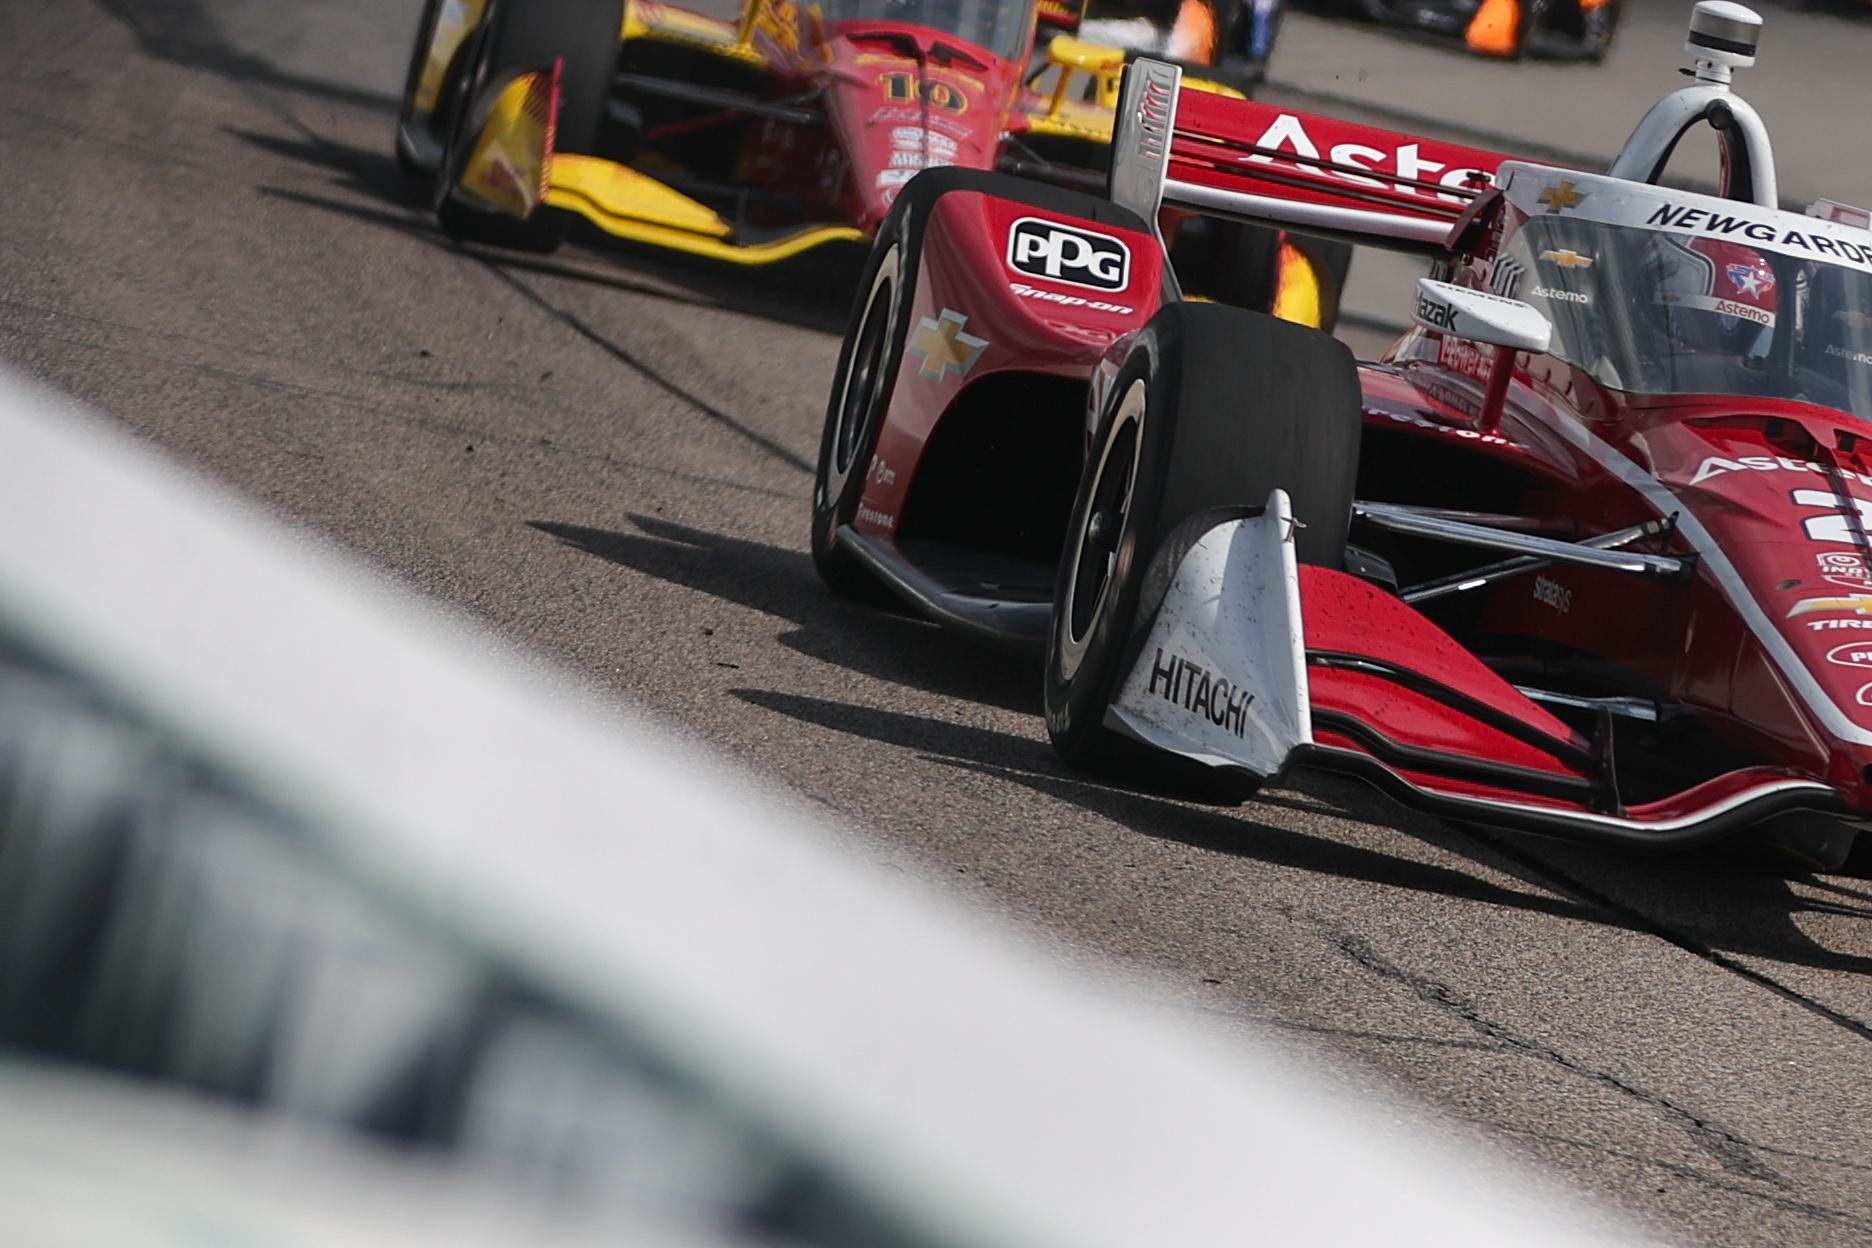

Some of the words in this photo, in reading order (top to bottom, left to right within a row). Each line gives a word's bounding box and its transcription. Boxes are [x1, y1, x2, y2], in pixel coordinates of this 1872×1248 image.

[1238, 113, 1498, 204] Aste
[1014, 229, 1123, 284] PPG
[1530, 285, 1589, 305] Astemo
[1714, 299, 1771, 325] Astemo
[1148, 647, 1255, 740] HITACHI
